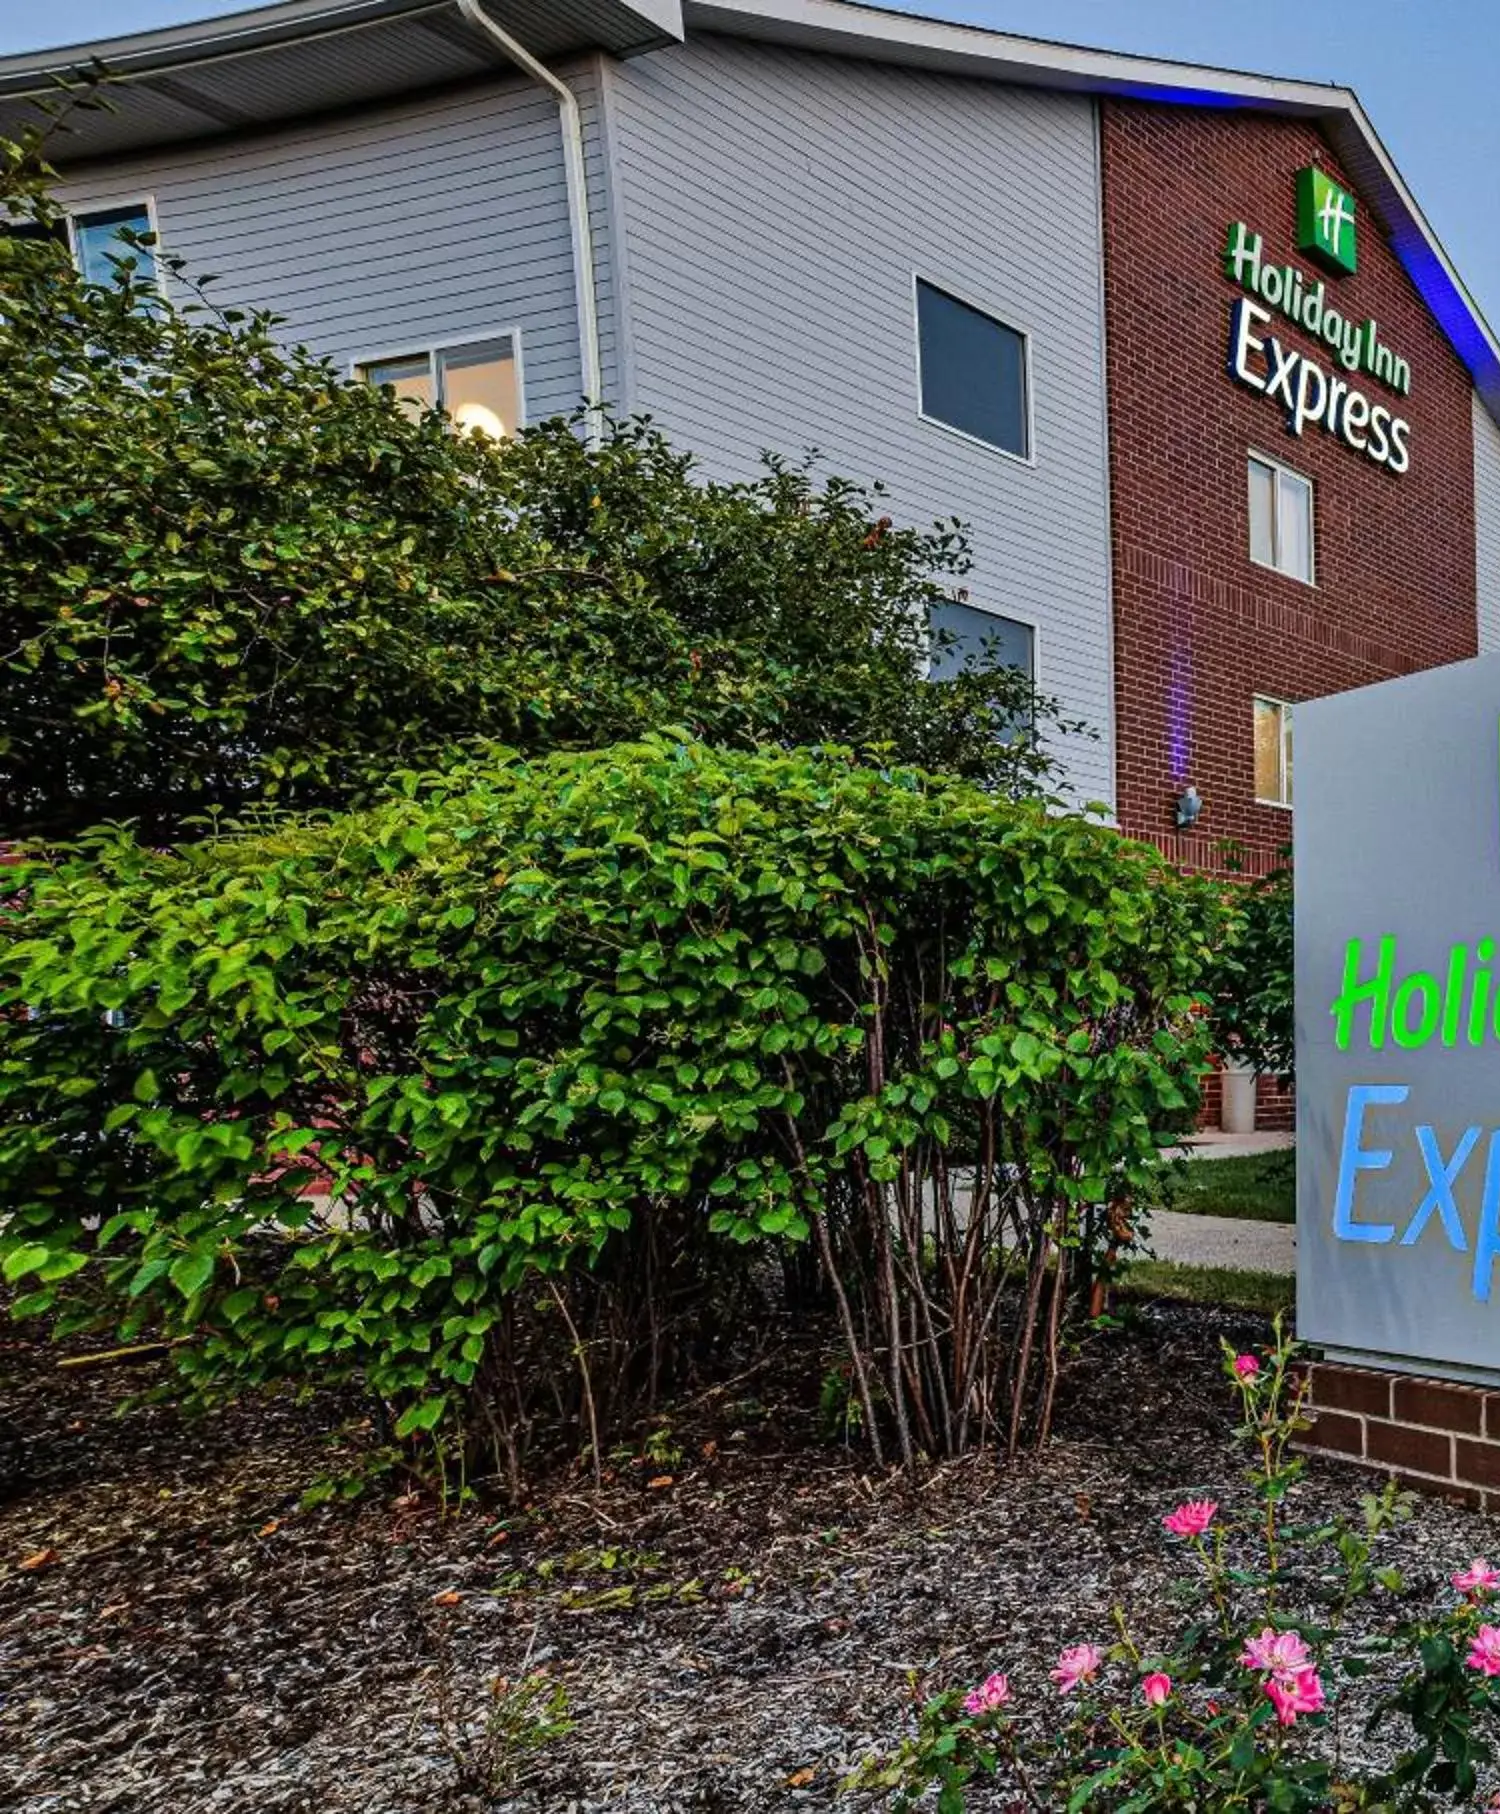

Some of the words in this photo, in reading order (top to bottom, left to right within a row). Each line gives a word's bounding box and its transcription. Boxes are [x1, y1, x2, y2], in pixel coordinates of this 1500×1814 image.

[1223, 220, 1363, 371] Holiday
[1360, 318, 1411, 396] Inn
[1229, 297, 1411, 474] Express
